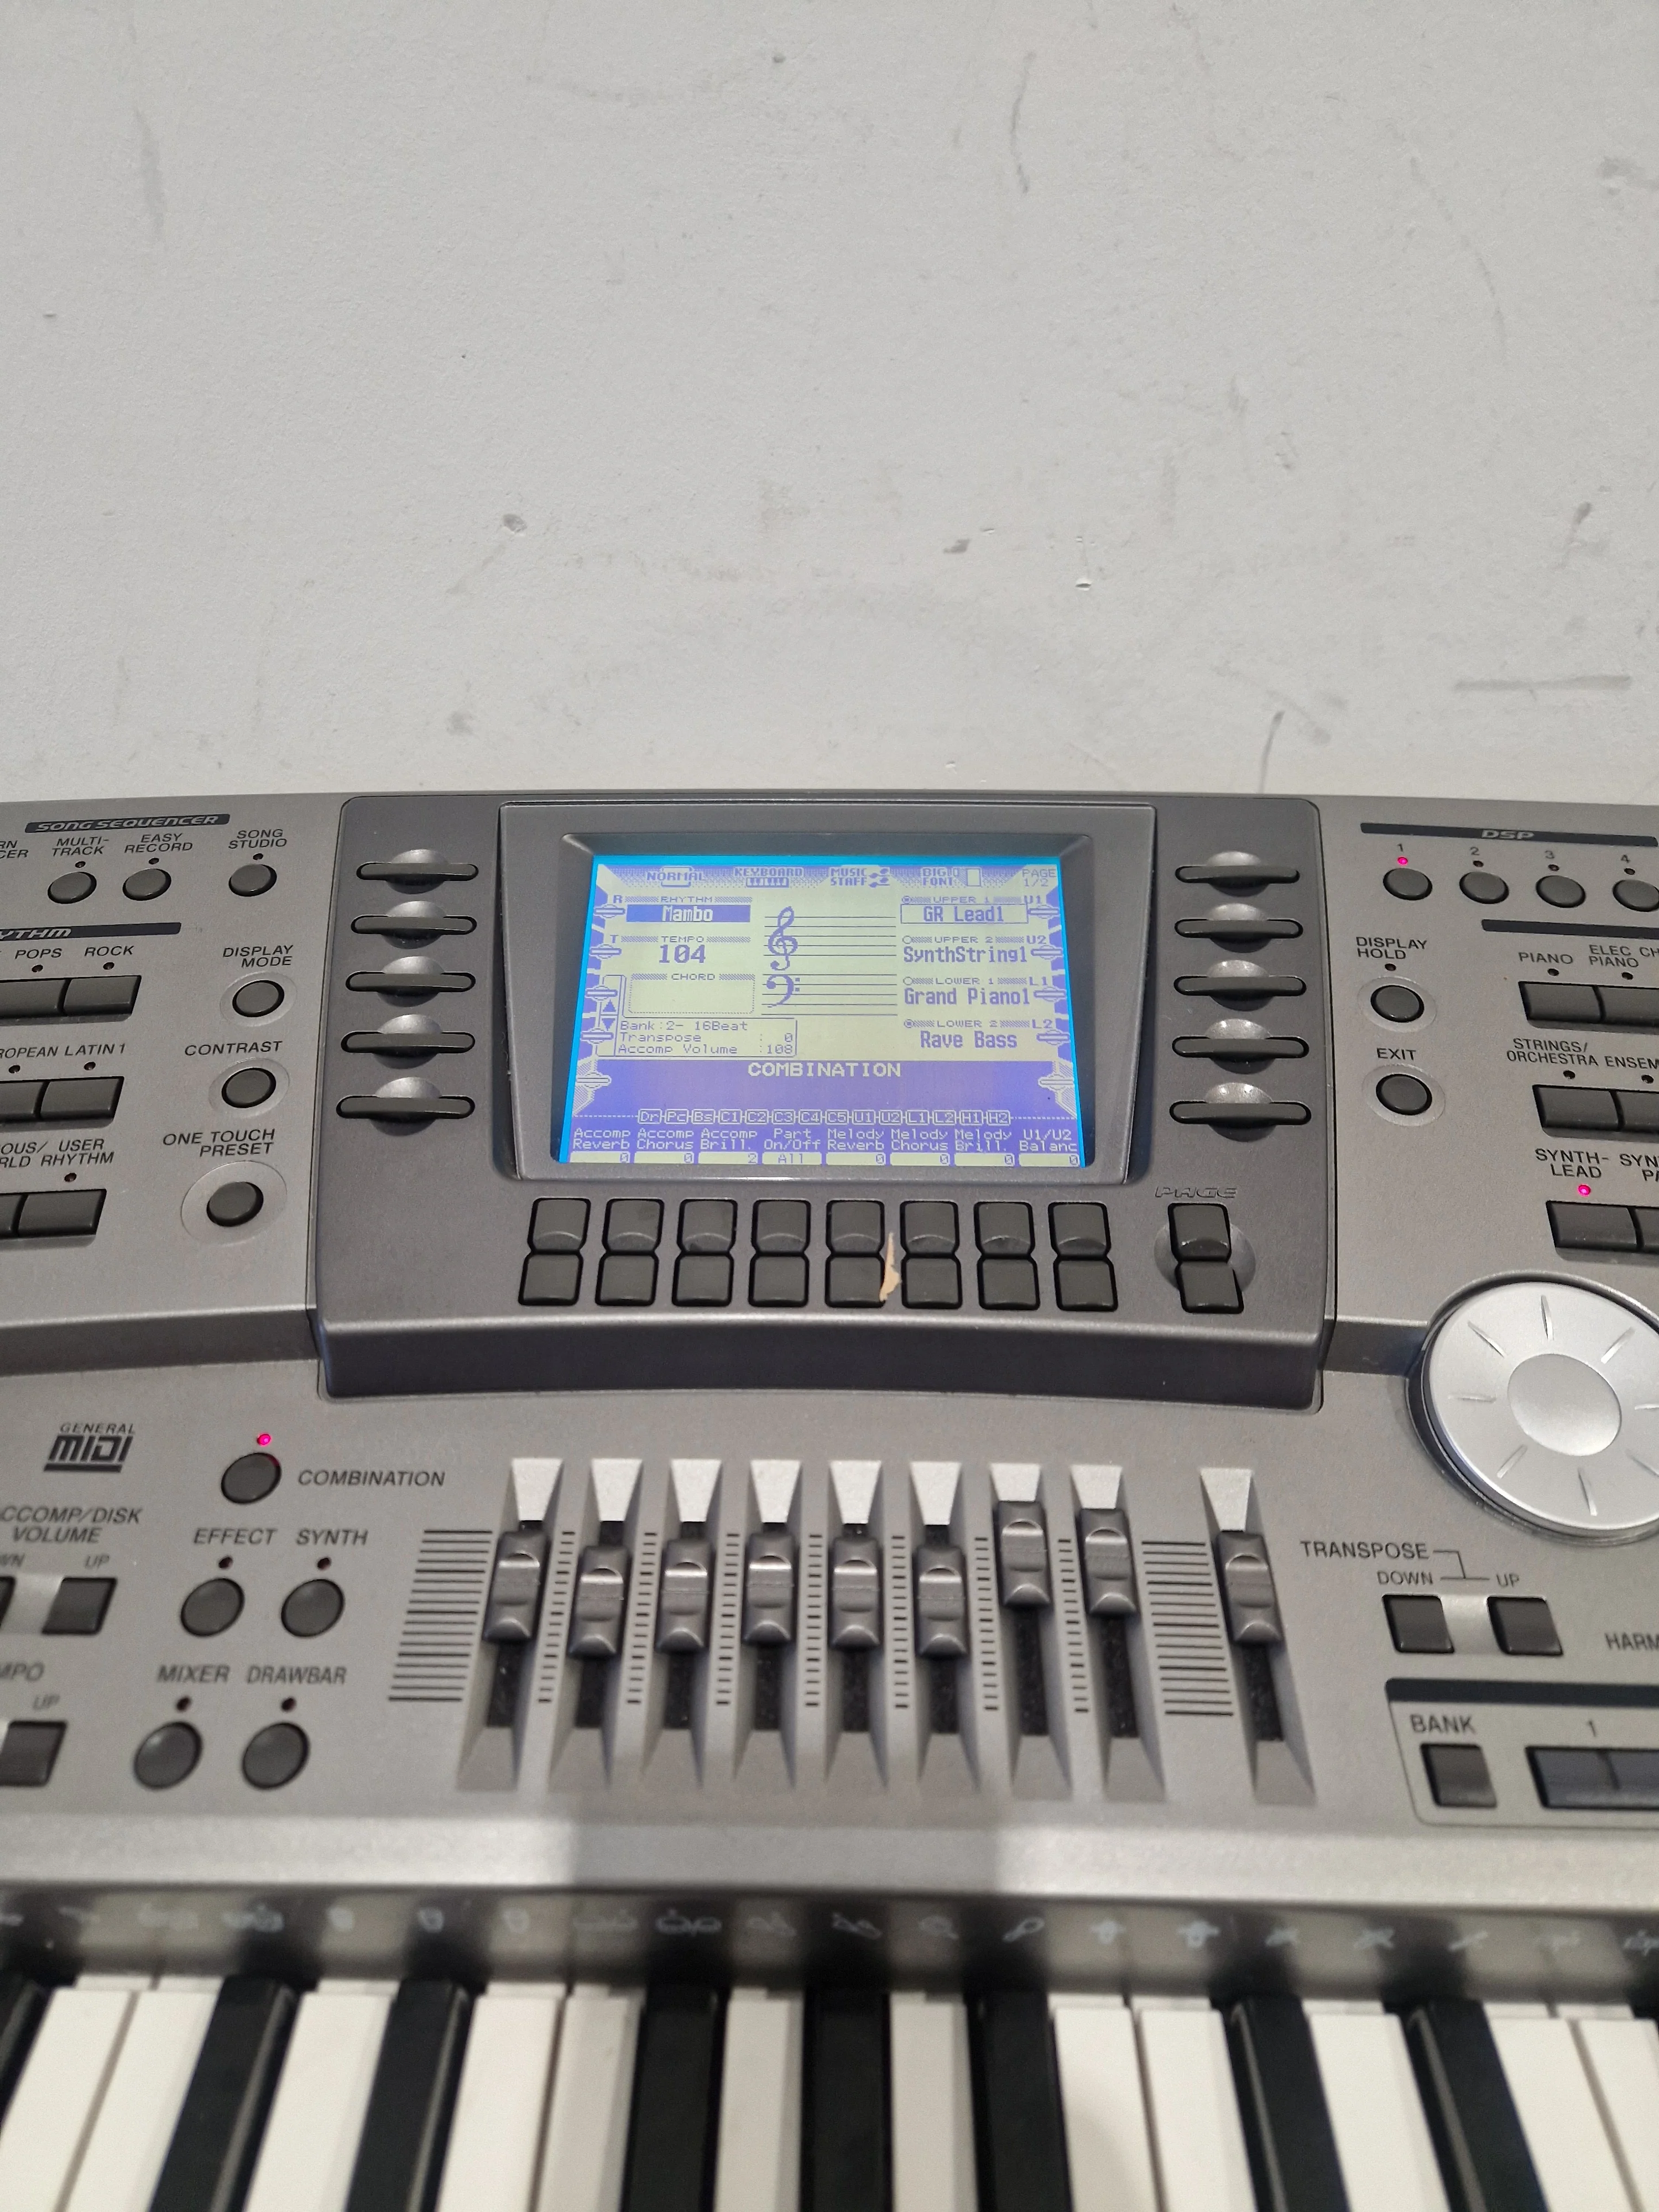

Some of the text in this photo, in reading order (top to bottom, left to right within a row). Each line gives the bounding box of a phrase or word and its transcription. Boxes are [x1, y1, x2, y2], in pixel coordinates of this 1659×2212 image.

[35, 815, 219, 831] SONG SEQUENCER
[141, 833, 183, 843] EASY
[237, 830, 283, 839] SONG
[1481, 830, 1535, 841] DSP
[56, 836, 109, 847] MULTI-
[228, 838, 288, 849] STUDIO
[52, 846, 105, 857] TRACK
[124, 842, 193, 853] RECORD
[1470, 847, 1479, 855] 2
[1545, 851, 1555, 859] 3
[1620, 854, 1630, 864] 4
[646, 872, 705, 881] NORMAL
[734, 868, 804, 877] KEYBOARD
[831, 868, 868, 877] MUSIC
[922, 868, 946, 877] BIG
[1022, 869, 1056, 878] PAGE
[831, 878, 868, 886] STAFF
[1024, 878, 1048, 886] 1/2
[613, 895, 623, 904] R
[1024, 895, 1043, 904] U1
[662, 906, 713, 922] Mambo
[924, 906, 1004, 922] GR Lead1
[610, 935, 619, 943] T
[1026, 936, 1046, 945] U2
[1356, 937, 1427, 950] DISPLAY
[14, 948, 63, 959] POPS
[84, 946, 134, 957] ROCK
[223, 945, 294, 958] DISPLAY
[659, 945, 706, 963] 104
[903, 946, 1027, 963] SynthString1
[1358, 948, 1406, 960] HOLD
[1589, 945, 1631, 956] ELEC
[241, 956, 293, 968] MODE
[1519, 952, 1573, 965] PIANO
[1589, 956, 1639, 968] PIANO
[1029, 977, 1048, 985] L1
[904, 988, 1030, 1005] Grand Piano1
[695, 1021, 748, 1031] 16Beat
[1032, 1019, 1052, 1029] L2
[620, 1032, 701, 1042] Transpose
[920, 1031, 1018, 1048] Rave Bass
[64, 1044, 126, 1056] LATIN 1
[184, 1041, 283, 1056] CONTRAST
[618, 1044, 673, 1053] Accomp
[683, 1044, 737, 1053] Volume
[1513, 1039, 1588, 1052] STRINGS/
[1376, 1048, 1416, 1060] EXIT
[1506, 1051, 1599, 1066] ORCHESTRA
[748, 1062, 901, 1077] COMBINATION
[640, 1112, 1008, 1123] Dr Pc Bs C1 C2 C3 C4 C5 U1 U2 L1 L2 H1 H2
[163, 1129, 275, 1146] ONE TOUCH
[573, 1129, 630, 1139] Accomp
[638, 1129, 694, 1138] Accomp
[701, 1129, 757, 1139] Accomp
[774, 1128, 811, 1138] Part
[827, 1128, 884, 1139] Melody
[891, 1128, 948, 1139] Melody
[954, 1129, 1012, 1140] Melody
[1023, 1129, 1072, 1140] U1/U2
[59, 1138, 105, 1152] USER
[199, 1142, 274, 1157] PRESET
[573, 1140, 630, 1149] Reverb
[637, 1139, 693, 1150] Chorus
[700, 1139, 751, 1150] Brill.
[764, 1139, 821, 1150] On/Off
[827, 1139, 884, 1150] Reverb
[891, 1139, 948, 1150] Chorus
[956, 1140, 1006, 1151] Brill.
[1019, 1140, 1077, 1151] Balanc
[40, 1151, 114, 1166] RHYTHM
[748, 1154, 757, 1164] 2
[778, 1154, 803, 1164] All
[1535, 1149, 1609, 1165] SYNTH-
[1551, 1165, 1601, 1178] LEAD
[1155, 1186, 1237, 1199] PAGE
[59, 1423, 134, 1434] GENERAL
[47, 1435, 134, 1462] MIDI
[298, 1470, 446, 1486] COMBINATION
[13, 1526, 103, 1543] VOLUME
[194, 1528, 368, 1546] EFFECT SYNTH
[1300, 1541, 1430, 1560] TRANSPOSE
[85, 1553, 109, 1569] UP
[1377, 1571, 1520, 1588] DOWN UP
[157, 1663, 347, 1685] MIXER DRAWBAR
[1410, 1713, 1477, 1735] BANK
[1586, 1720, 1597, 1737] 1
